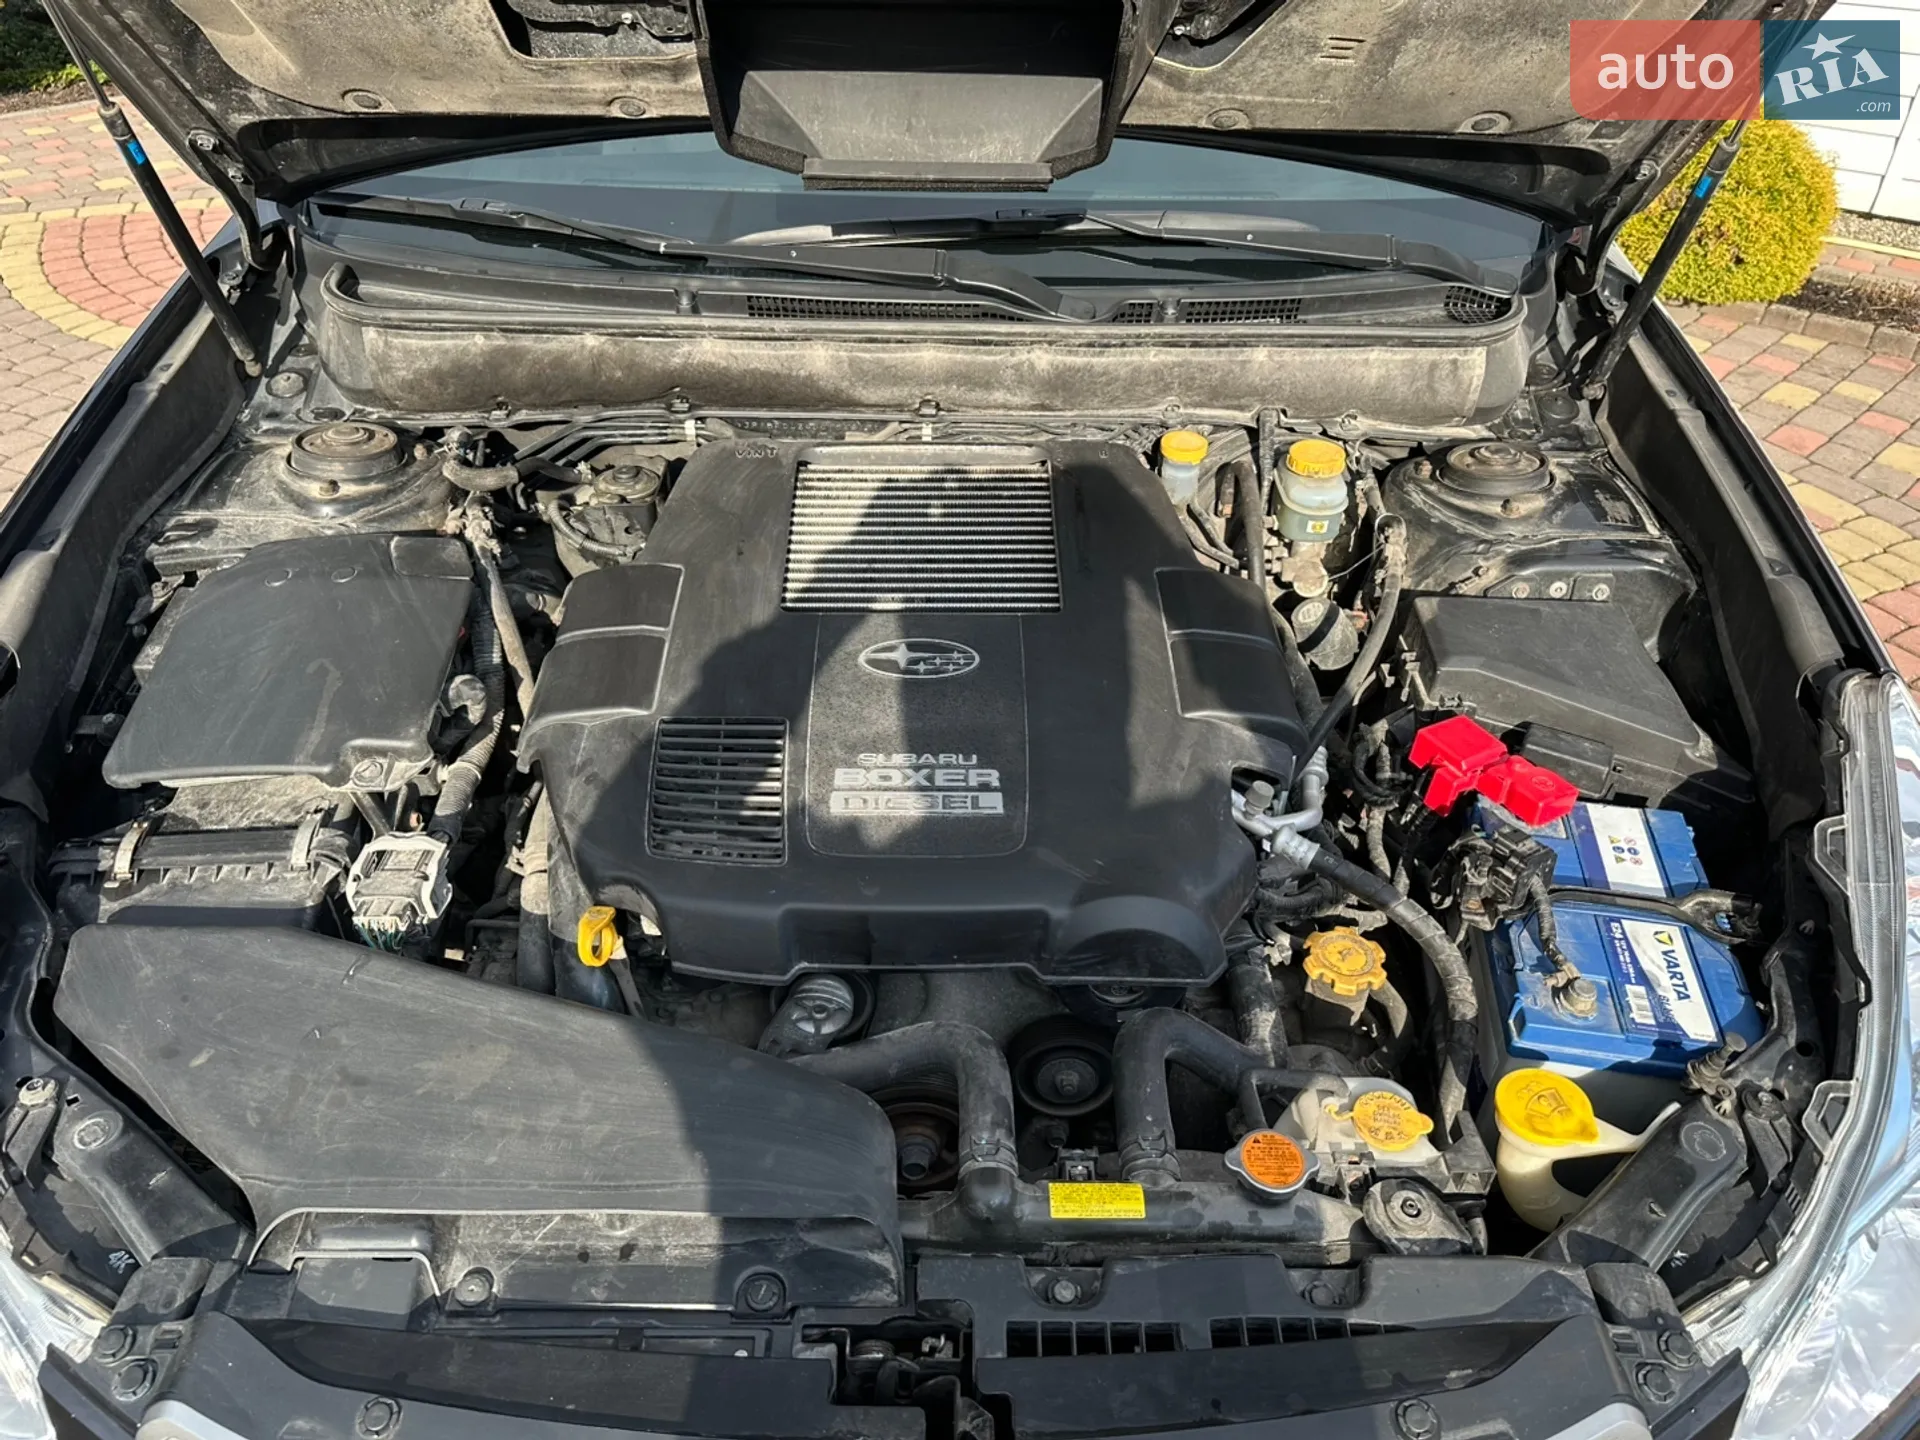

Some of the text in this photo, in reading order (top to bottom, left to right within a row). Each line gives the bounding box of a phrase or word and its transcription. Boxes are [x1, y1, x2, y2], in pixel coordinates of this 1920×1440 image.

[858, 753, 977, 766] SUBARU
[834, 768, 1000, 788] BOXER
[842, 793, 999, 811] DIESEL
[1660, 948, 1692, 1002] VARTA
